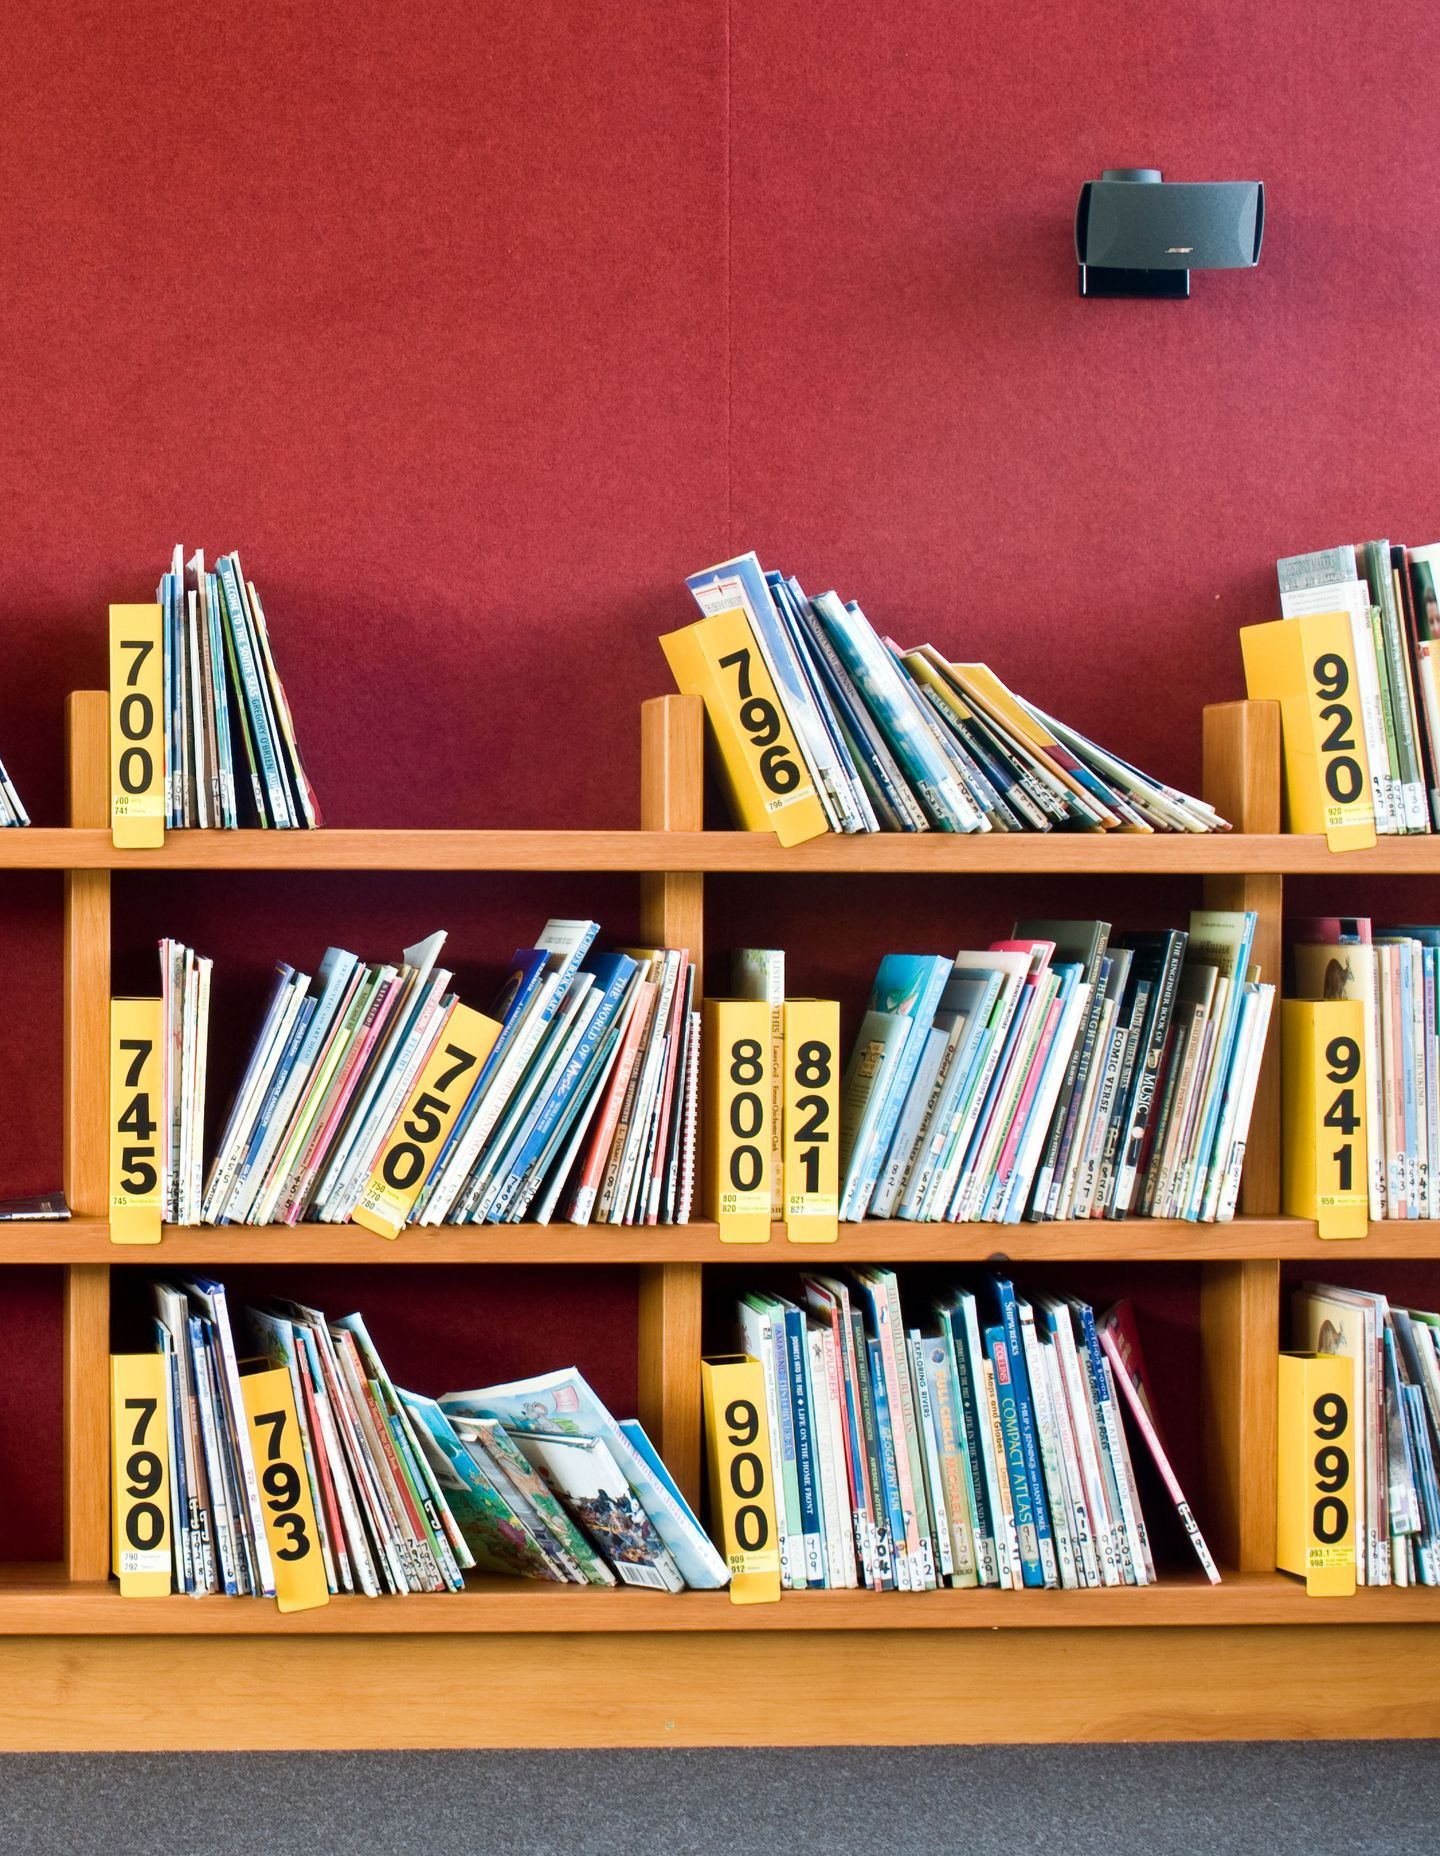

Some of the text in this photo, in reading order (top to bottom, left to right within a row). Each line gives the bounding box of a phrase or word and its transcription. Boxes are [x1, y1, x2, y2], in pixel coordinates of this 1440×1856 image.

[222, 569, 239, 612] WELCOME
[231, 612, 241, 624] TO
[234, 626, 246, 643] THE
[238, 644, 252, 673] SOUTH
[119, 641, 154, 794] 700
[245, 673, 257, 696] SEAS
[250, 697, 266, 733] GREGORY
[718, 648, 800, 794] 796
[1313, 653, 1363, 804] 920
[768, 799, 783, 811] 796
[174, 956, 182, 988] Collage
[544, 963, 577, 1013] BOOK OF ART
[607, 973, 628, 999] THE
[772, 959, 783, 993] LISTEN
[576, 1042, 591, 1059] OF
[586, 1000, 613, 1041] WORLD
[771, 1010, 781, 1033] THIS
[1077, 975, 1108, 1081] THE NIGHT KITE
[1136, 940, 1182, 1115] THE KINGFISHER BOOK OF MUSIC
[937, 1043, 956, 1078] Oxford
[1097, 1030, 1125, 1114] COMIC VERSE
[1416, 1053, 1424, 1105] THE VIKINGS
[118, 1039, 157, 1195] 745
[383, 1044, 477, 1189] 750
[730, 1038, 763, 1192] 800
[794, 1040, 831, 1193] 821
[1323, 1036, 1361, 1190] 941
[113, 1197, 127, 1206] 745
[367, 1190, 381, 1201] 770
[372, 1181, 386, 1192] 750
[773, 1328, 786, 1374] AMAZING
[887, 1286, 914, 1433] THE FAMILY PICTURE ATLAS
[995, 1344, 1008, 1382] COLLINS
[1004, 1301, 1020, 1355] SHIPWRECKS
[822, 1339, 839, 1401] EXPLORERS
[913, 1341, 931, 1418] EXPLORING RIVERS
[1084, 1358, 1108, 1450] EXPLORING THE POLES
[933, 1370, 963, 1516] FULL CIRCLE MICHAEL
[985, 1371, 1004, 1454] Maps and Globes
[125, 1398, 164, 1551] 790
[254, 1410, 310, 1561] 793
[725, 1400, 769, 1551] 900
[796, 1407, 814, 1514] LIFE ON THE HOME FRONT
[868, 1455, 879, 1490] AWESOME
[878, 1423, 902, 1511] GEOGRAPHY FUN
[964, 1410, 985, 1519] LIFE IN THE TWENTIES AND
[1000, 1396, 1032, 1522] COMPACT ATLAS
[1019, 1401, 1041, 1506] PHILIP JENNINGS DANY
[1313, 1393, 1349, 1544] 990
